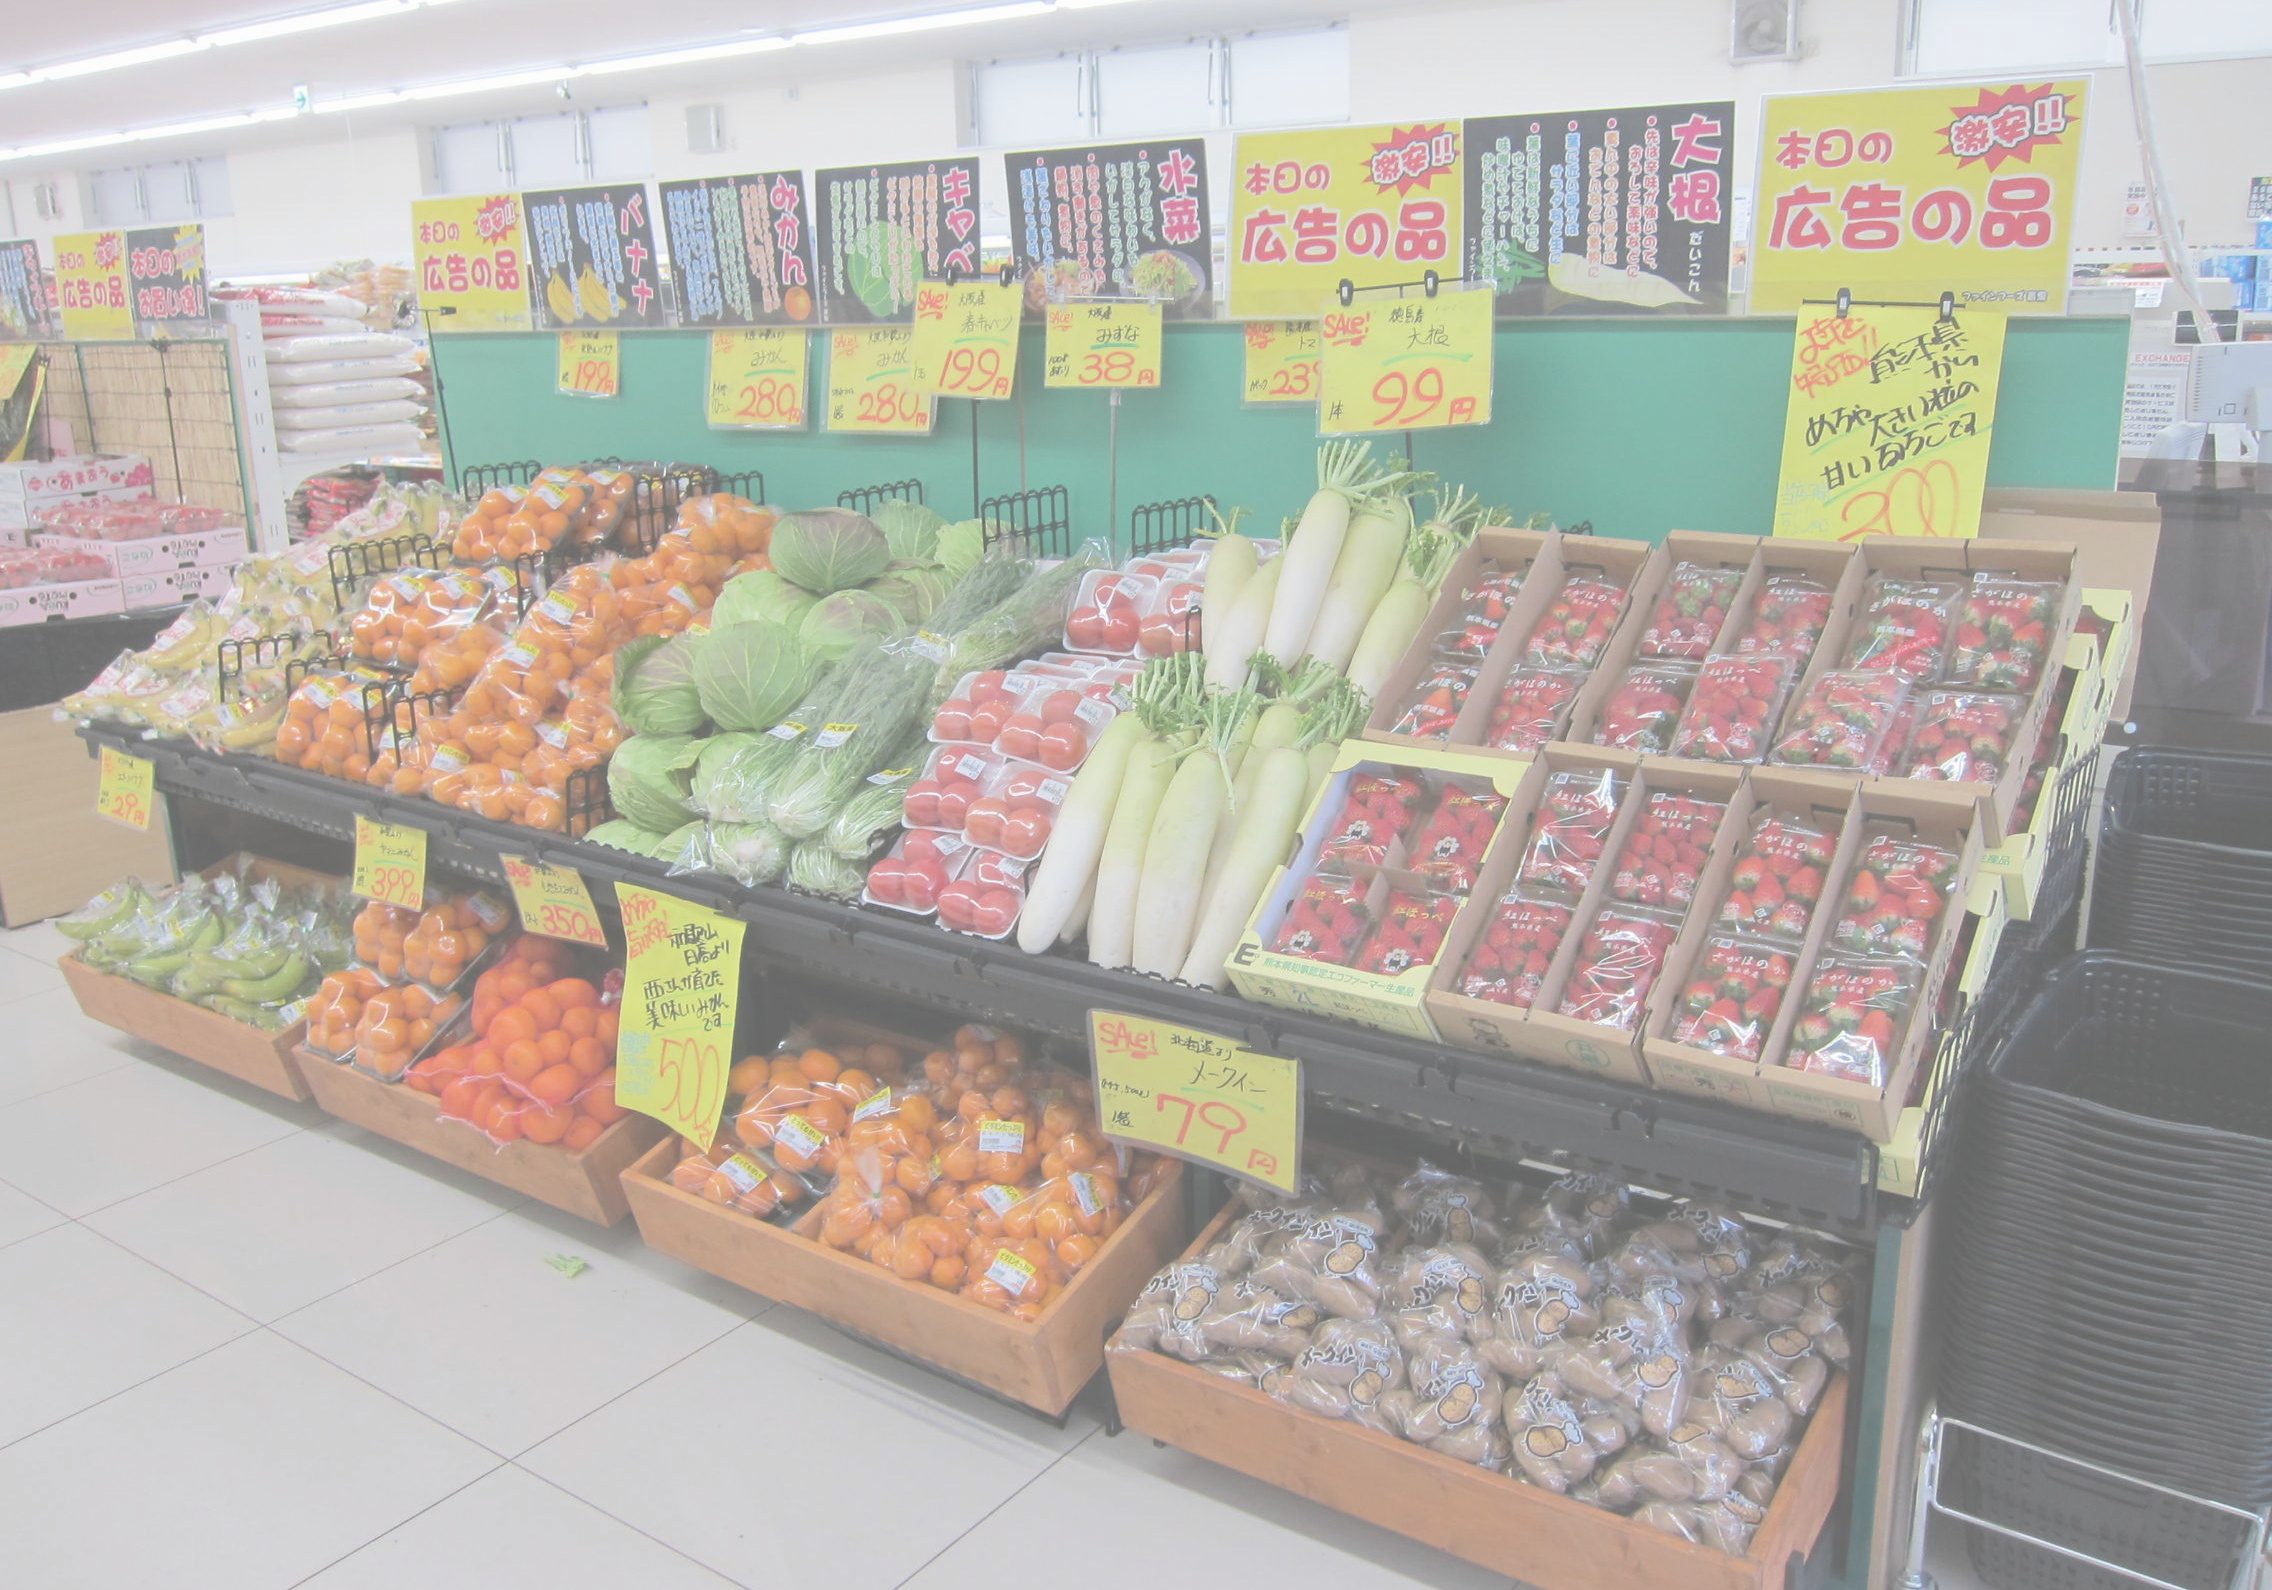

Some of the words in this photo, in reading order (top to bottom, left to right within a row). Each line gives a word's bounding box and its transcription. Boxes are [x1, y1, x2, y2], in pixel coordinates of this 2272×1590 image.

[1776, 128, 1893, 170] 本日の
[1951, 94, 2066, 156] 激安!!
[1244, 161, 1331, 195] 本日の
[1372, 134, 1455, 184] 激安!!
[1667, 113, 1722, 224] 大根
[1137, 161, 1157, 243] アクがなく、
[1157, 149, 1201, 245] 水菜
[1626, 145, 1644, 278] おろして薬味などに
[1642, 128, 1660, 270] 先は辛味が強いので、
[1768, 175, 2054, 250] 広告の品
[419, 221, 459, 243] 本日の
[621, 193, 653, 316] バナナ
[770, 174, 807, 285] みかん
[1241, 200, 1447, 264] 広告の品
[131, 247, 175, 279] 本日の
[423, 249, 521, 292] 広告の品
[1688, 230, 1704, 292] だいこん
[63, 274, 126, 309] 広告の品
[1097, 325, 1140, 343] みずな
[1407, 324, 1450, 350] 大根
[2135, 354, 2190, 363] EXCHANGE
[1233, 943, 1259, 966] E
[1189, 1061, 1267, 1092] メークイン
[1157, 1093, 1277, 1175] 79円
